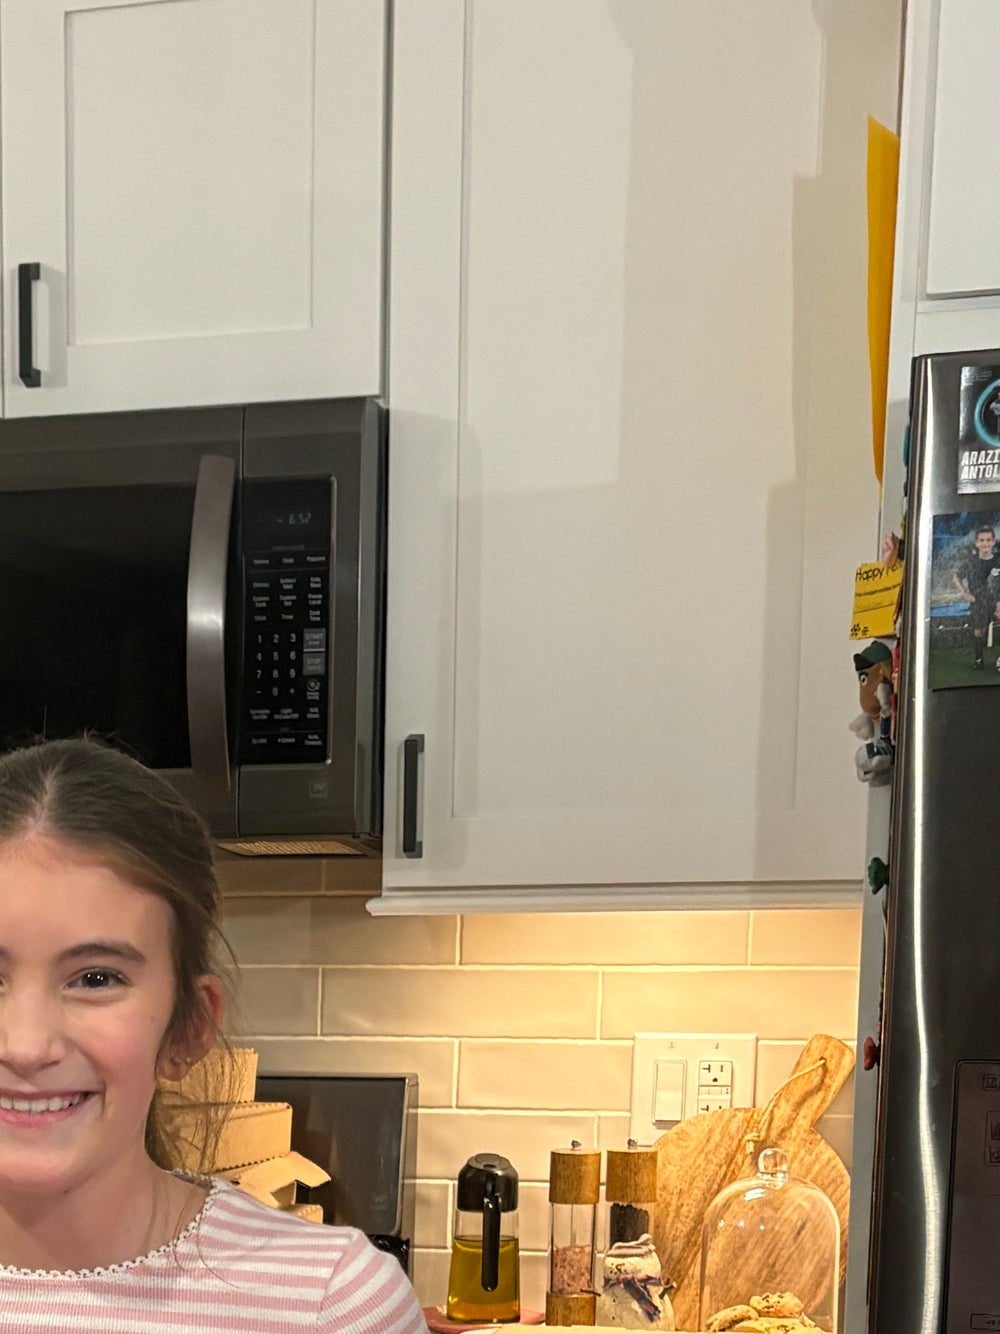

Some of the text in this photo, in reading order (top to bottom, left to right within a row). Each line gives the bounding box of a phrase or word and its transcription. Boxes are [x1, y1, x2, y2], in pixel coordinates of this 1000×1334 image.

[855, 566, 884, 582] Happy
[273, 634, 279, 643] 2
[289, 633, 296, 642] 3
[273, 651, 279, 661] 5
[289, 650, 296, 660] 6
[256, 669, 262, 679] 7
[272, 668, 279, 678] 8
[289, 668, 296, 678] 9
